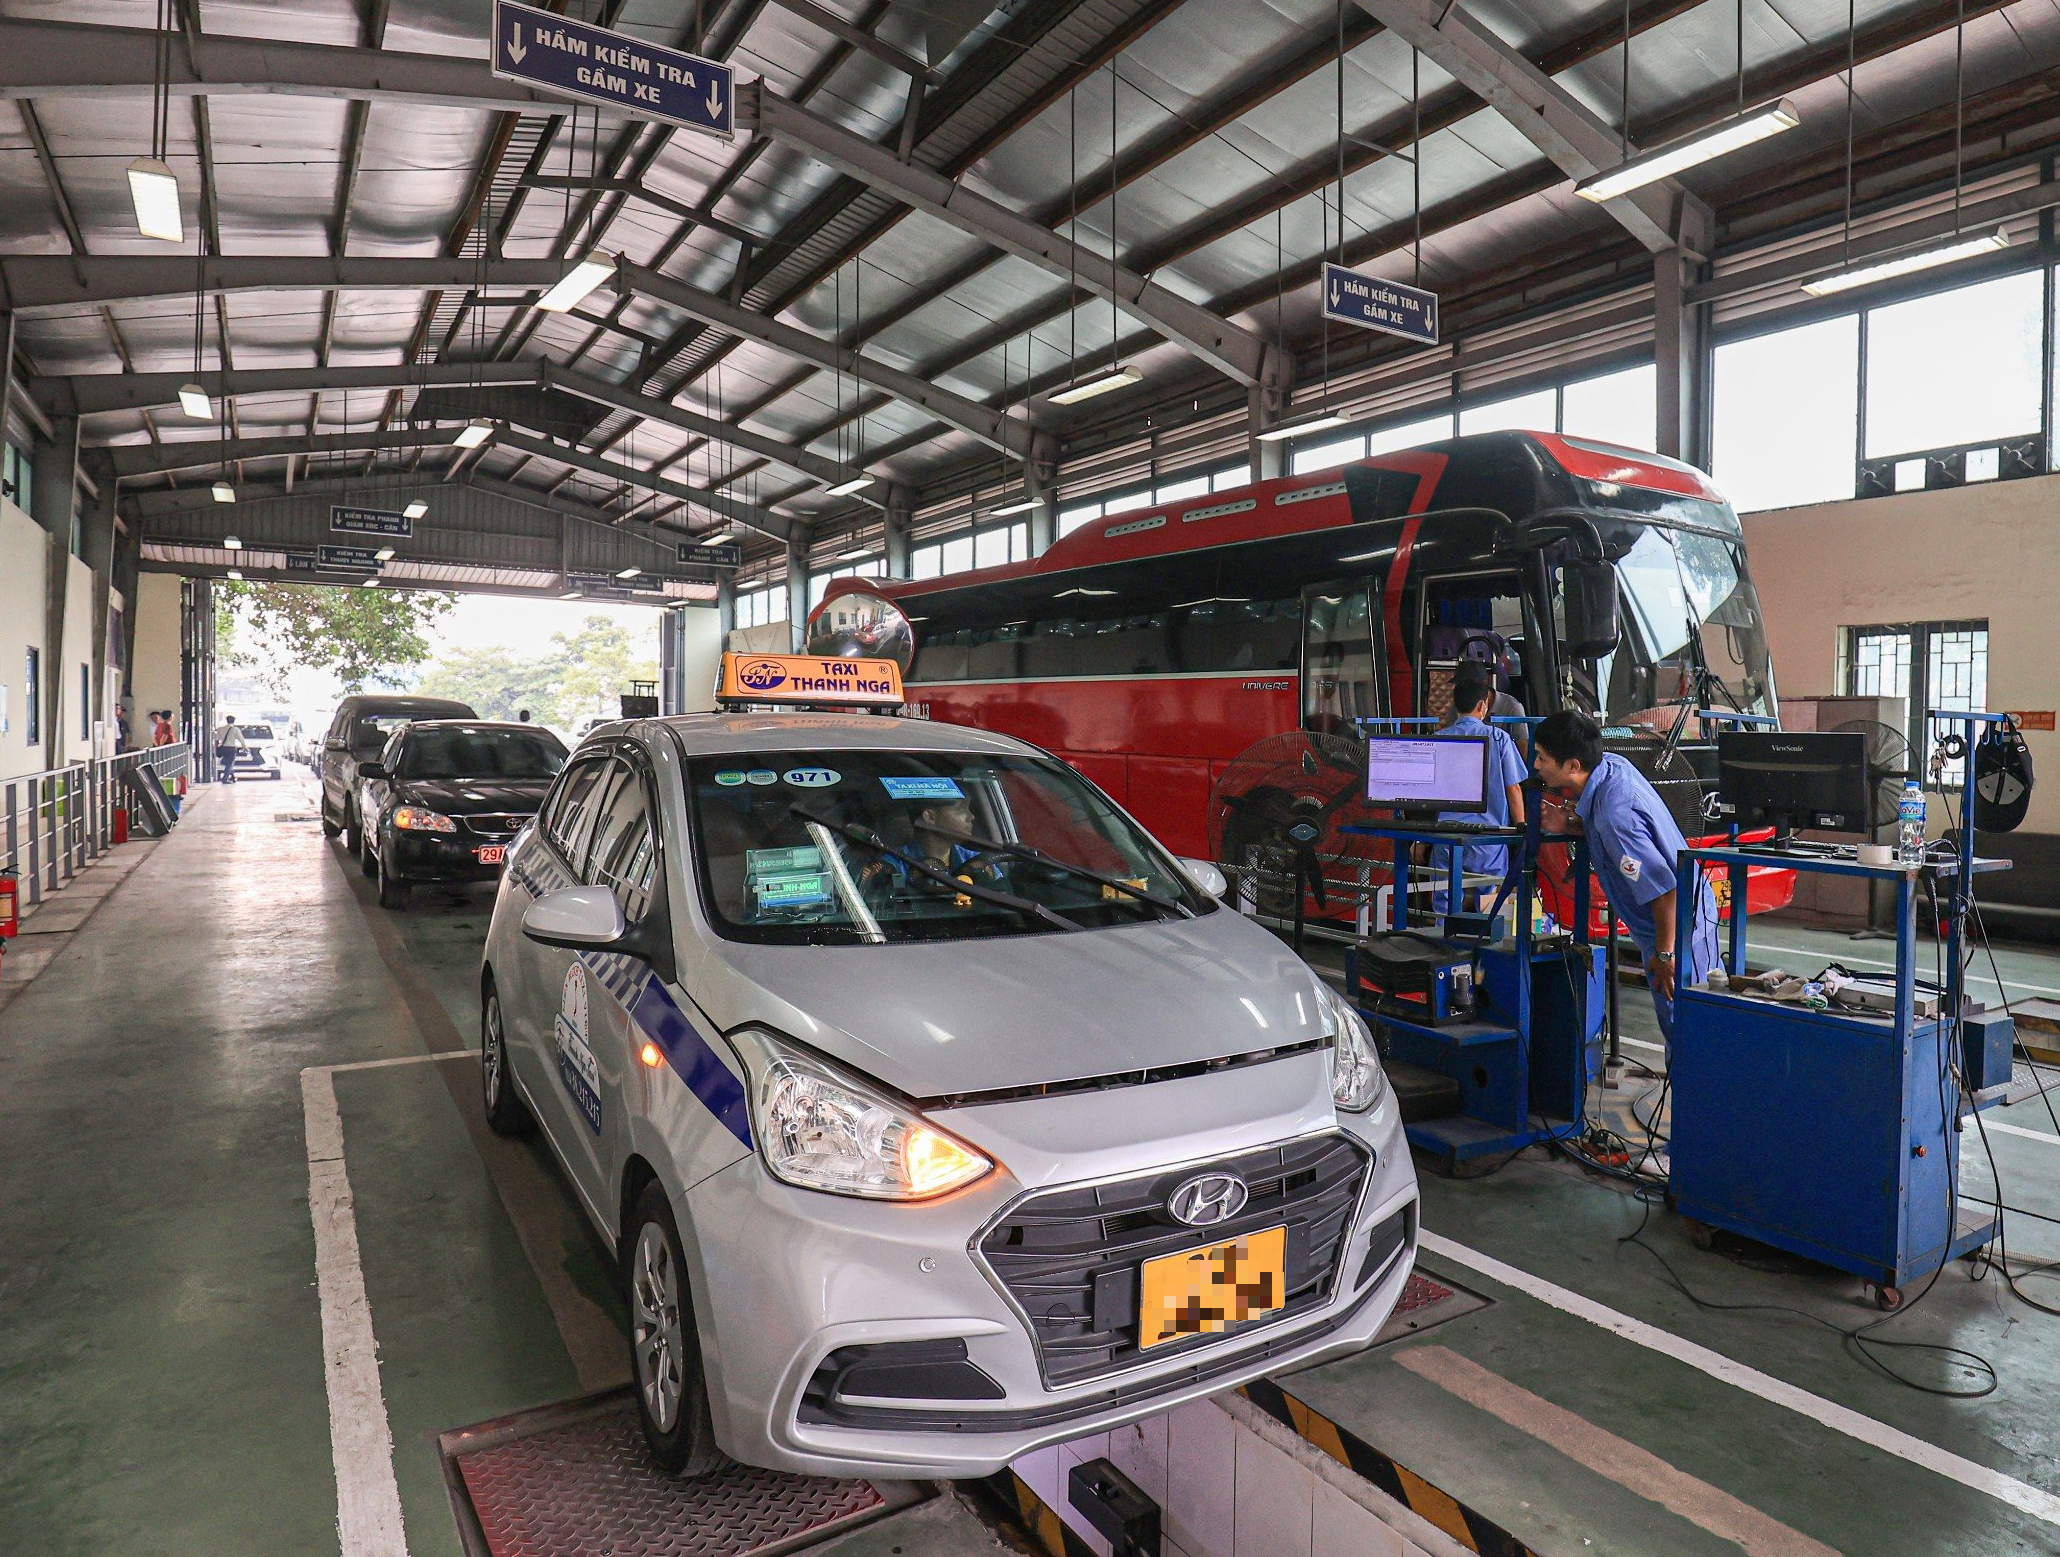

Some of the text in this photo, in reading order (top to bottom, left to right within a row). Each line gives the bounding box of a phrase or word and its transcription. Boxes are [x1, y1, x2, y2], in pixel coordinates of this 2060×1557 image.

[536, 28, 696, 88] HẦM KIỂM TRA
[577, 66, 661, 104] GẦM XE
[1344, 280, 1420, 311] HẦM KIỂM TRA
[1363, 303, 1404, 325] GẦM XE
[821, 662, 858, 676] TAXI
[791, 676, 891, 693] THANH NGA
[1771, 744, 1804, 752] ViewSonic
[790, 772, 832, 783] 971
